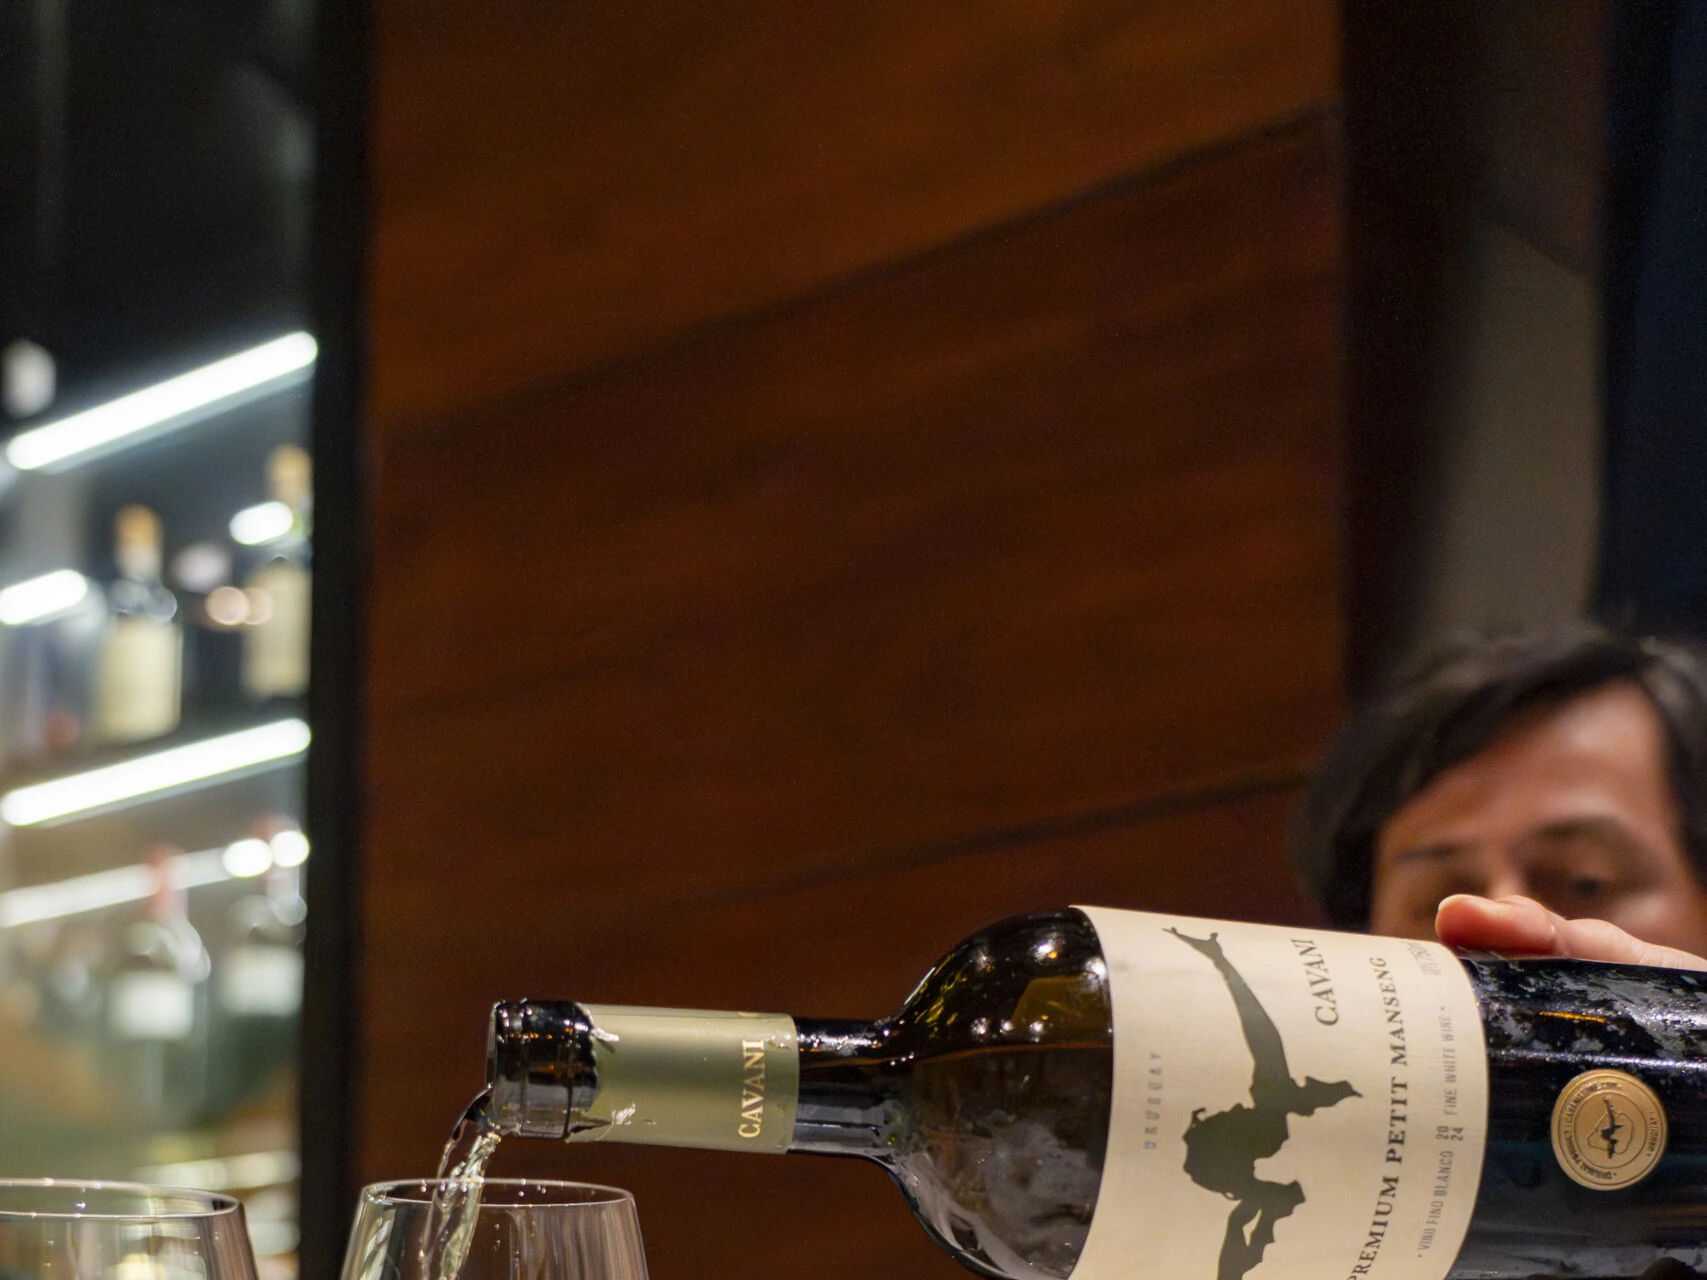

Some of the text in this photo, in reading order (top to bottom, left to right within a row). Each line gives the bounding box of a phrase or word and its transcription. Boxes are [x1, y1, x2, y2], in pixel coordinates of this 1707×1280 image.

[1290, 938, 1339, 1026] CAVANI
[1369, 957, 1407, 1067] MANSENG
[738, 1039, 766, 1138] CAVANI
[1143, 1052, 1162, 1150] URUGUAY
[1438, 1015, 1458, 1116] FINE WHITE WINE
[1385, 1076, 1408, 1164] PETIT
[1436, 1125, 1450, 1141] 20
[1450, 1126, 1464, 1141] 24
[1418, 1150, 1454, 1250] VINO FINO BLANCO
